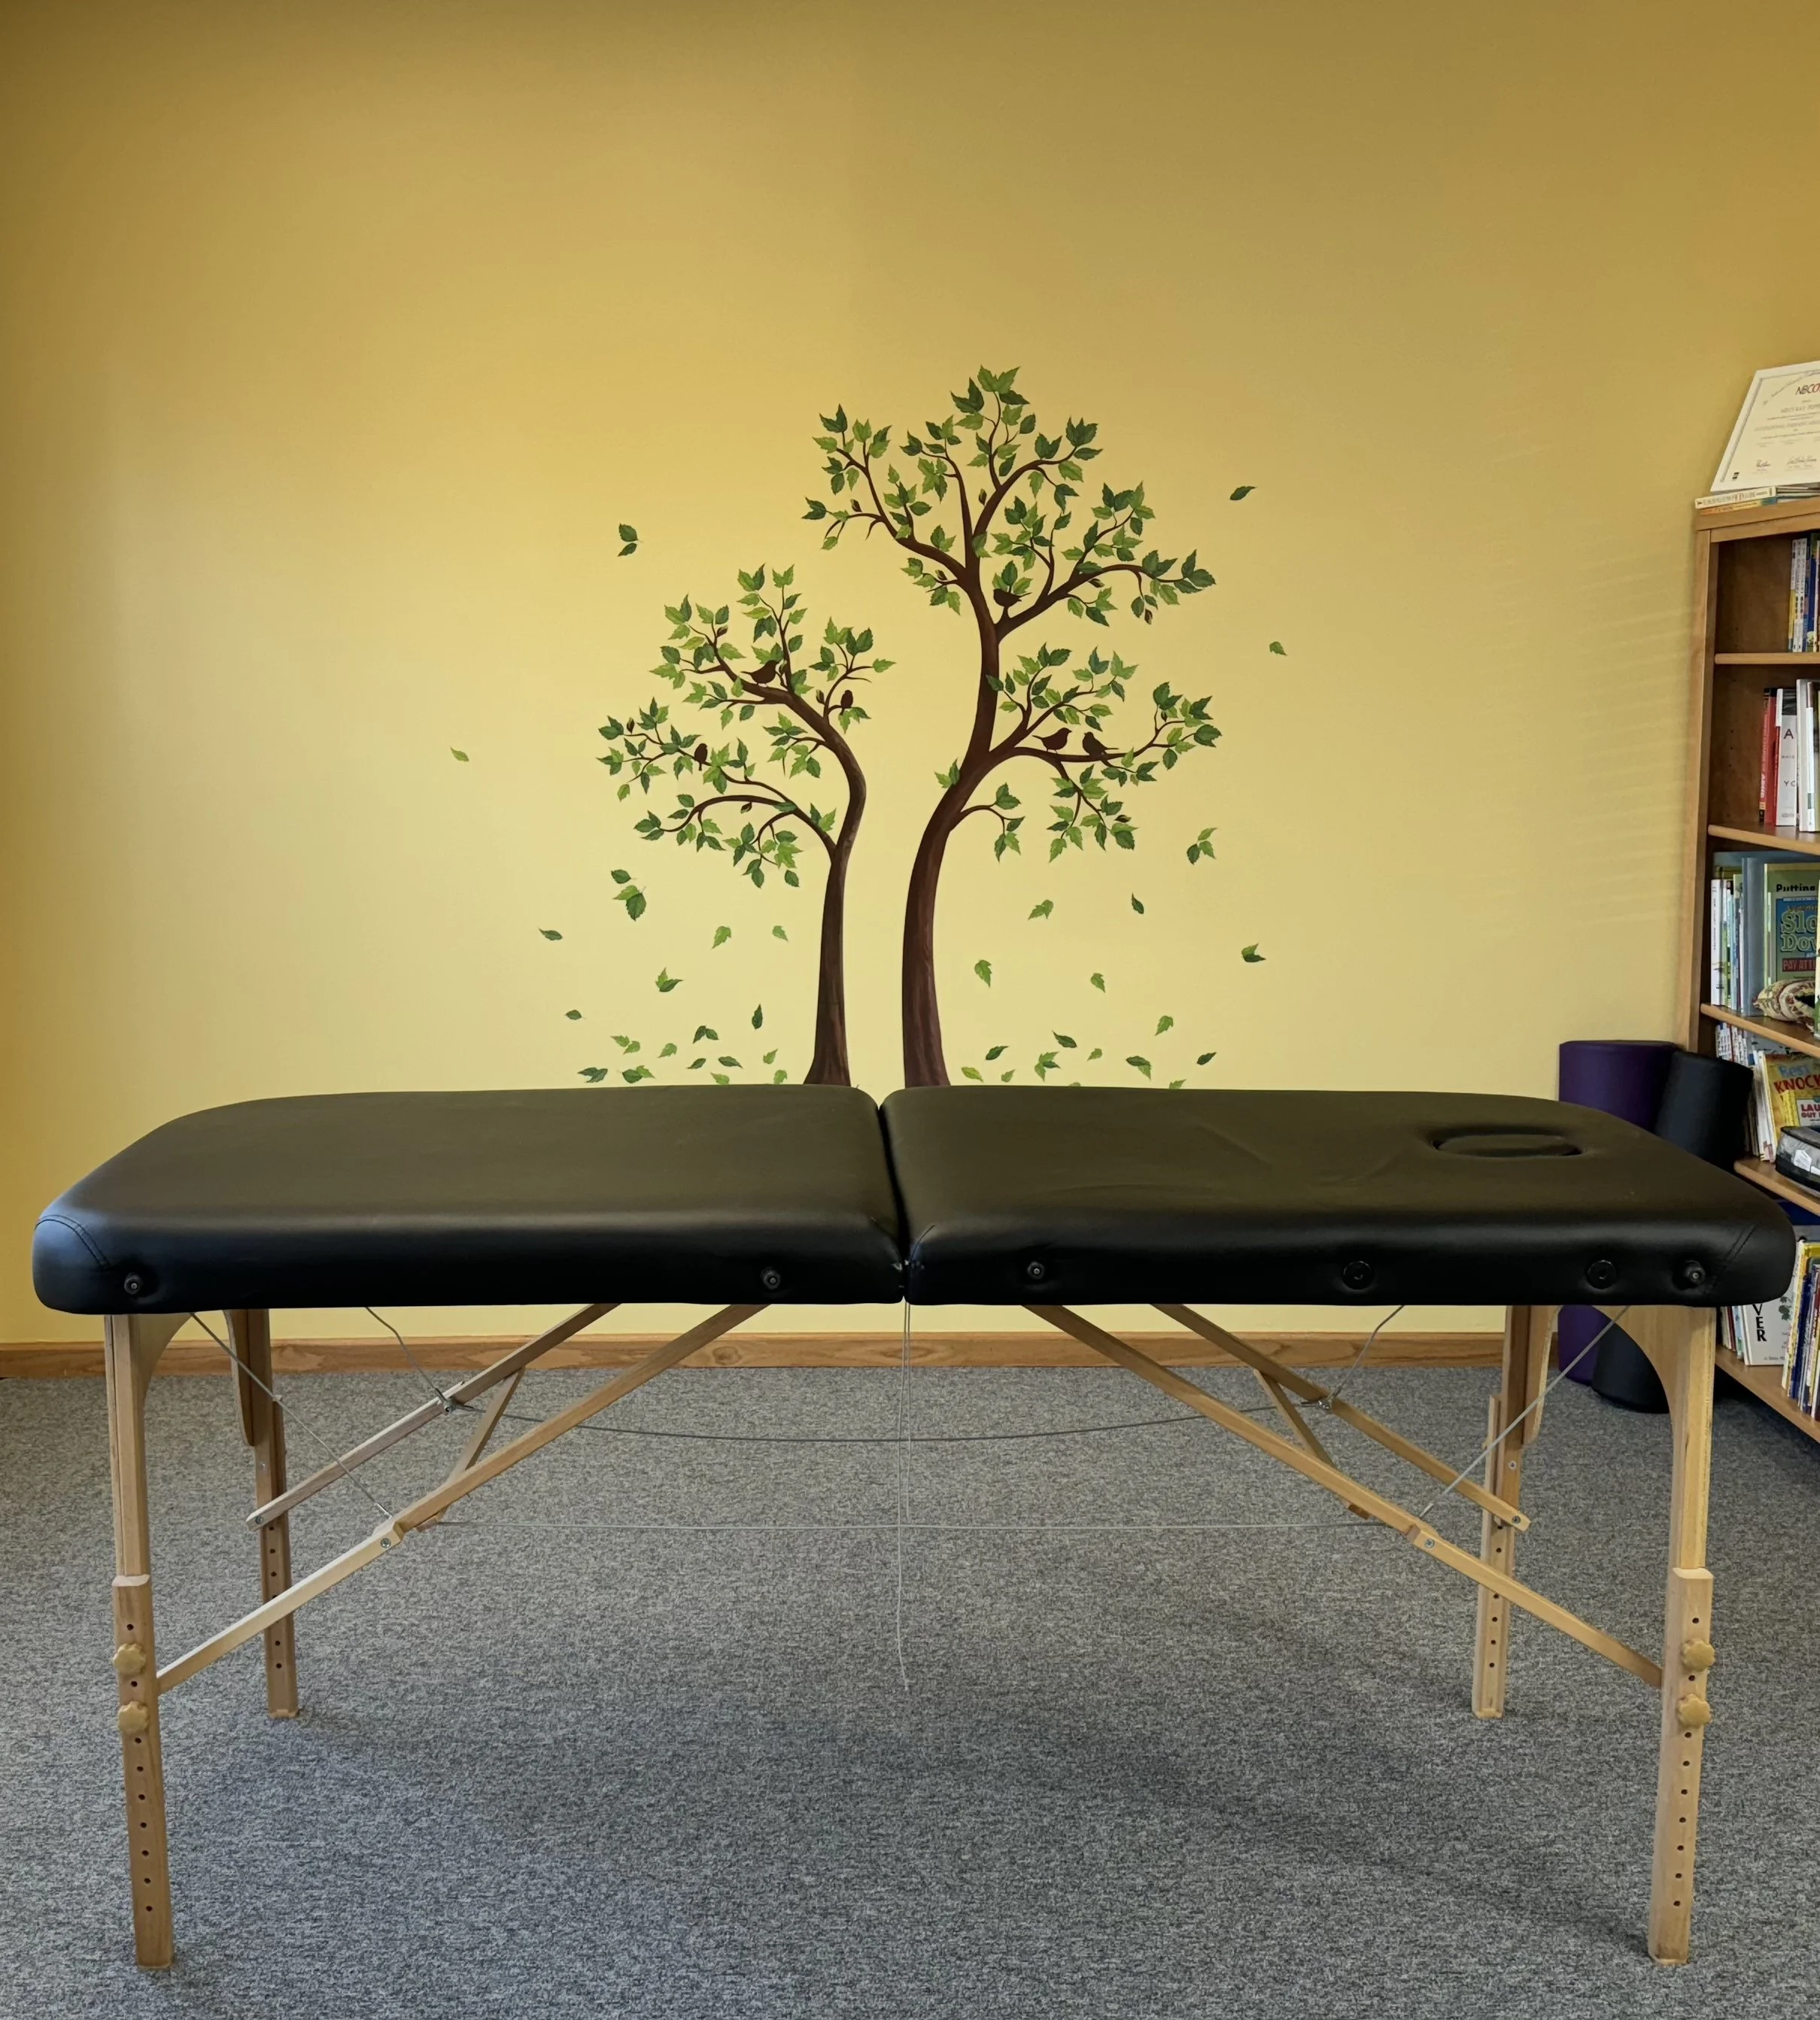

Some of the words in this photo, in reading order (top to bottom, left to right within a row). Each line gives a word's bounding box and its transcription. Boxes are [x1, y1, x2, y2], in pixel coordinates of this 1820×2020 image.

[1795, 383, 1820, 396] NBCO
[1781, 910, 1817, 934] Slo
[1800, 1104, 1820, 1112] LAU
